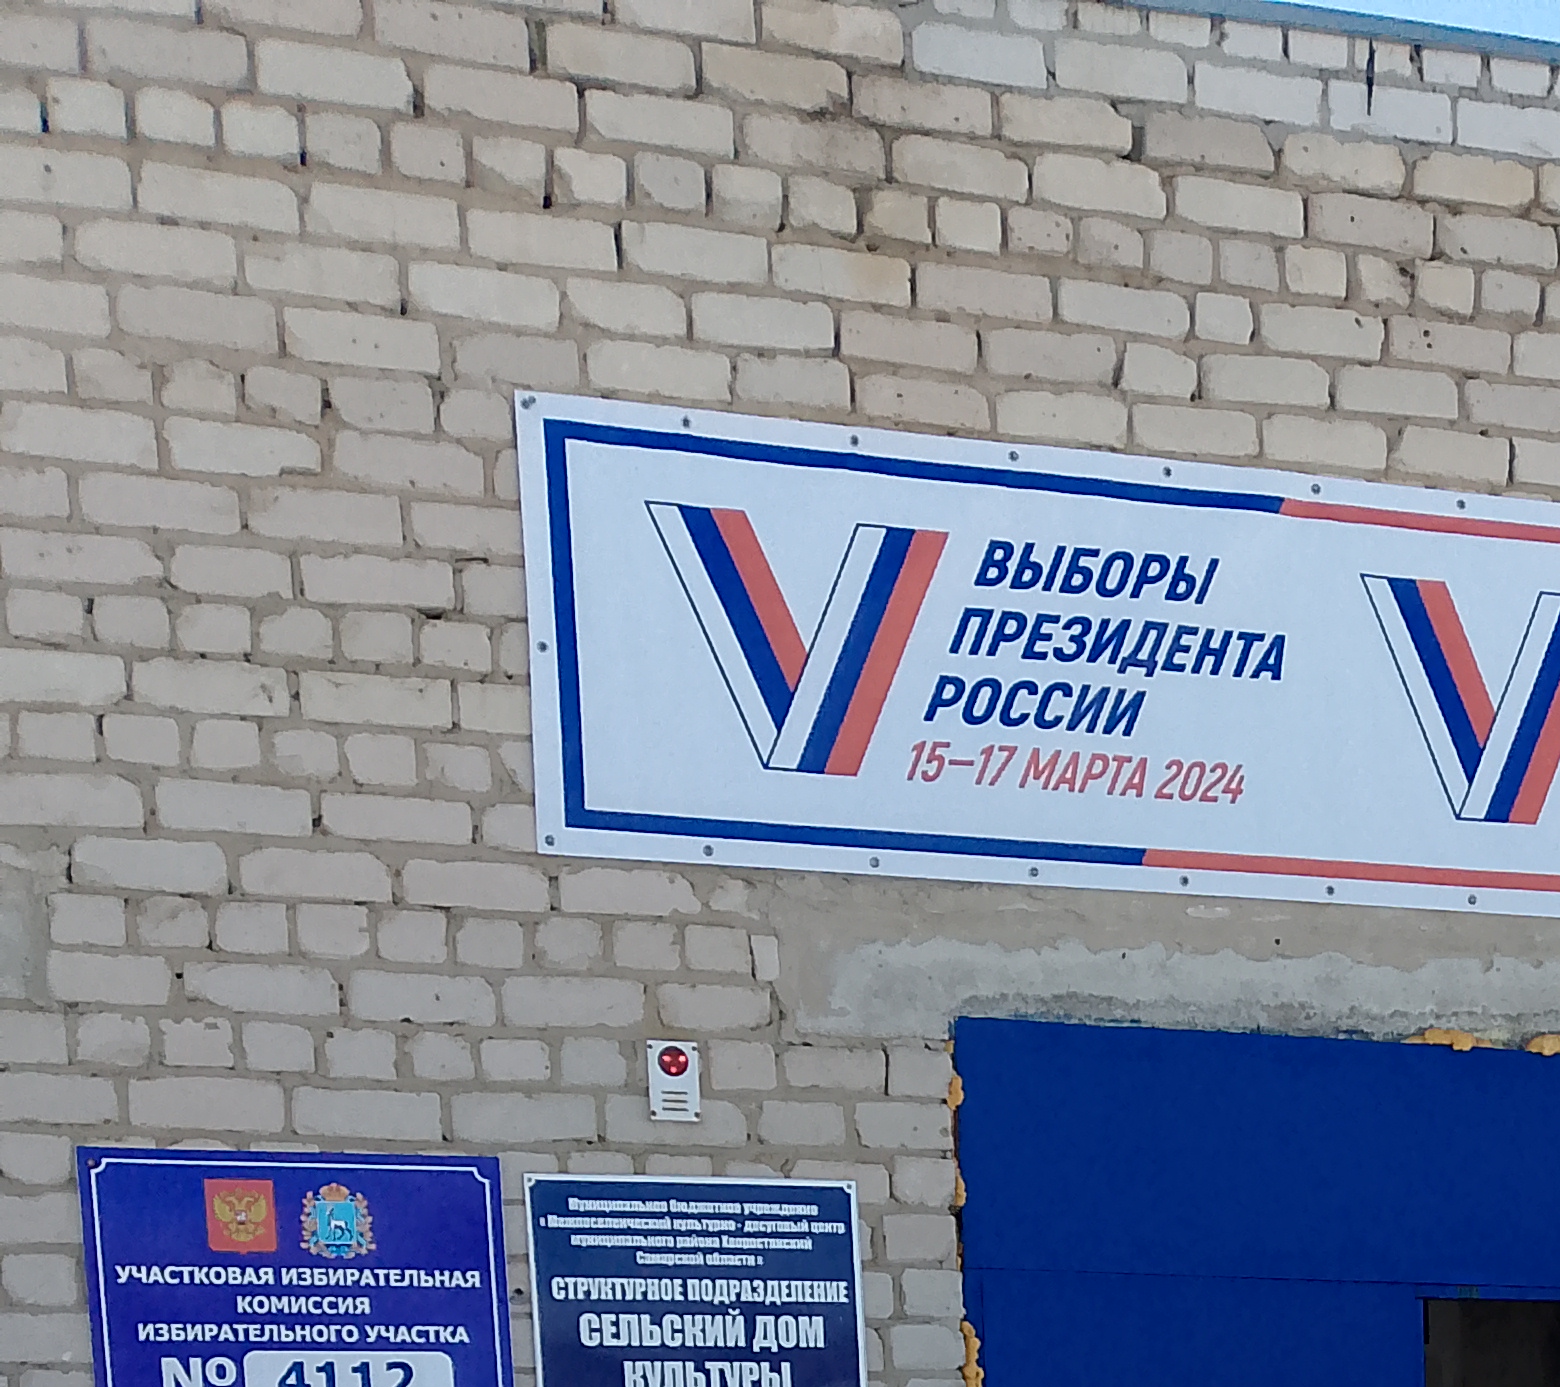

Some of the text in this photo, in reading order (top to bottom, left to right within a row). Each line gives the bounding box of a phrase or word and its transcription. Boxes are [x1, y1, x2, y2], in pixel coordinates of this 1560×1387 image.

[973, 539, 1220, 605] ВЫБОРЫ
[949, 607, 1286, 682] ПРЕЗИДЕНТА
[923, 674, 1147, 738] РОССИИ
[1019, 748, 1148, 799] МАРТА
[1154, 758, 1246, 805] 2024
[114, 1265, 482, 1288] УЧАСТКОВАЯ ИЗБИРАТЕЛЬНАЯ
[551, 1276, 849, 1306] СТРУКТУРНОЕ ПОДРАЗДЕЛЕНИЕ
[237, 1295, 371, 1315] КОМИССИЯ
[137, 1322, 470, 1344] ИЗБИРАТЕЛЬНОГО УЧАСТКА
[579, 1309, 825, 1353] СЕЛЬСКИЙ ДОМ
